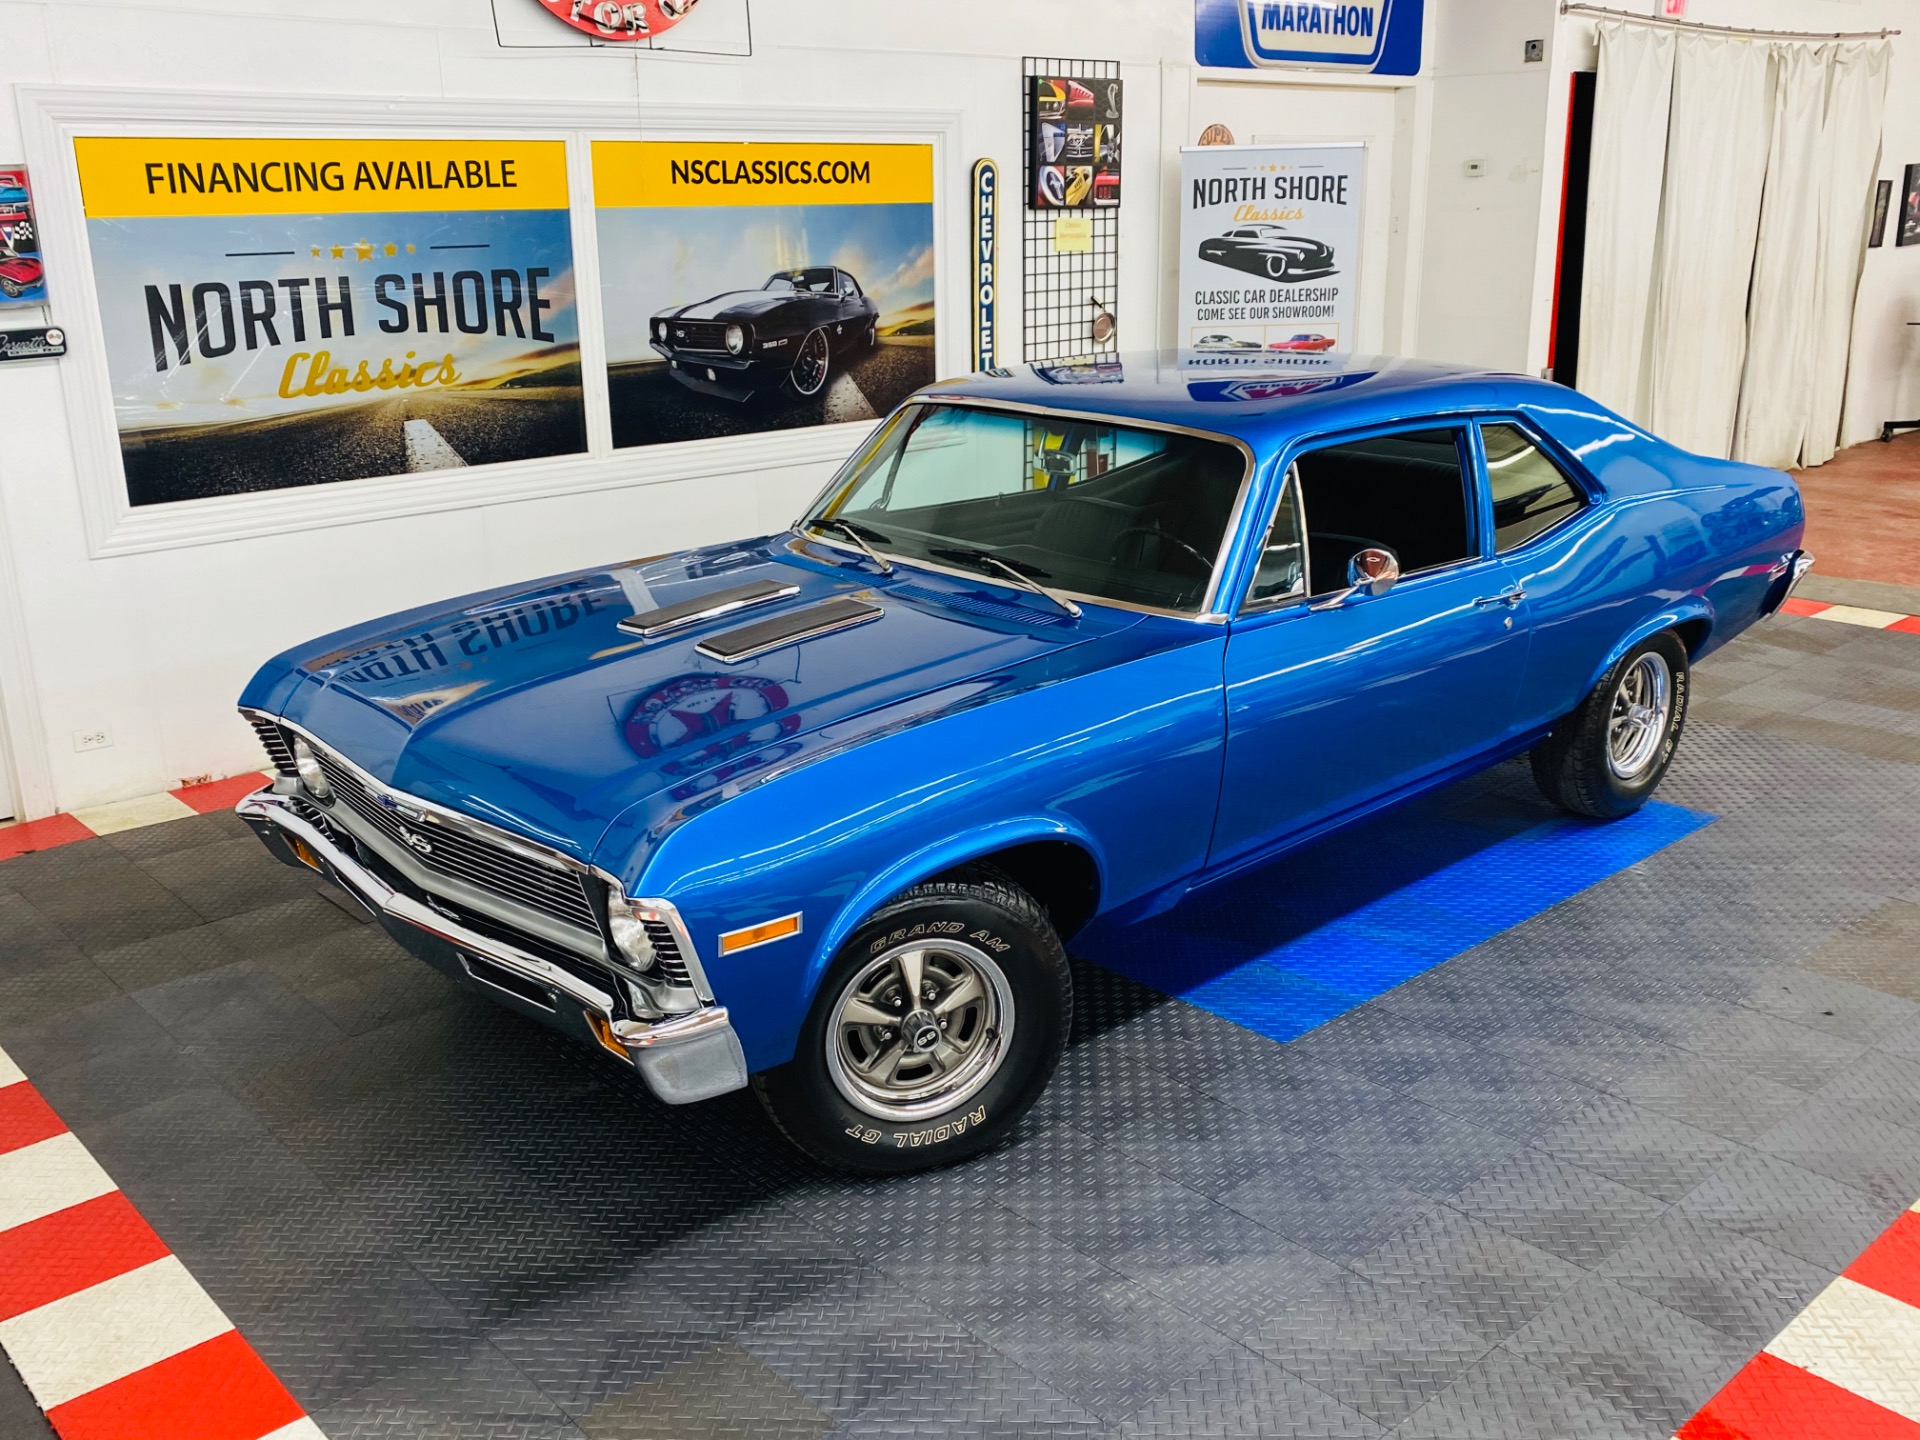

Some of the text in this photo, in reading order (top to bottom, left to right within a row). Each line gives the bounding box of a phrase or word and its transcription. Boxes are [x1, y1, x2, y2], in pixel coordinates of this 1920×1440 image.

[1261, 2, 1374, 37] MARATHON
[144, 159, 518, 194] FINANCING AVAILABLE
[671, 160, 870, 185] NSCLASSICS.COM
[1193, 175, 1348, 209] NORTH SHORE
[1233, 204, 1305, 222] Classics
[979, 171, 993, 372] CHEVROLET
[1195, 288, 1339, 305] CLASSIC CAR DEALERSHIP
[1197, 305, 1334, 321] COME SEE OUR SHOWROOM!
[144, 266, 555, 373] NORTH SHORE
[277, 349, 462, 399] Classics
[1670, 672, 1684, 732] RADIAL
[870, 921, 1010, 953] GRAND AM
[917, 1031, 936, 1046] SS
[845, 1105, 986, 1148] RADIAL GT
